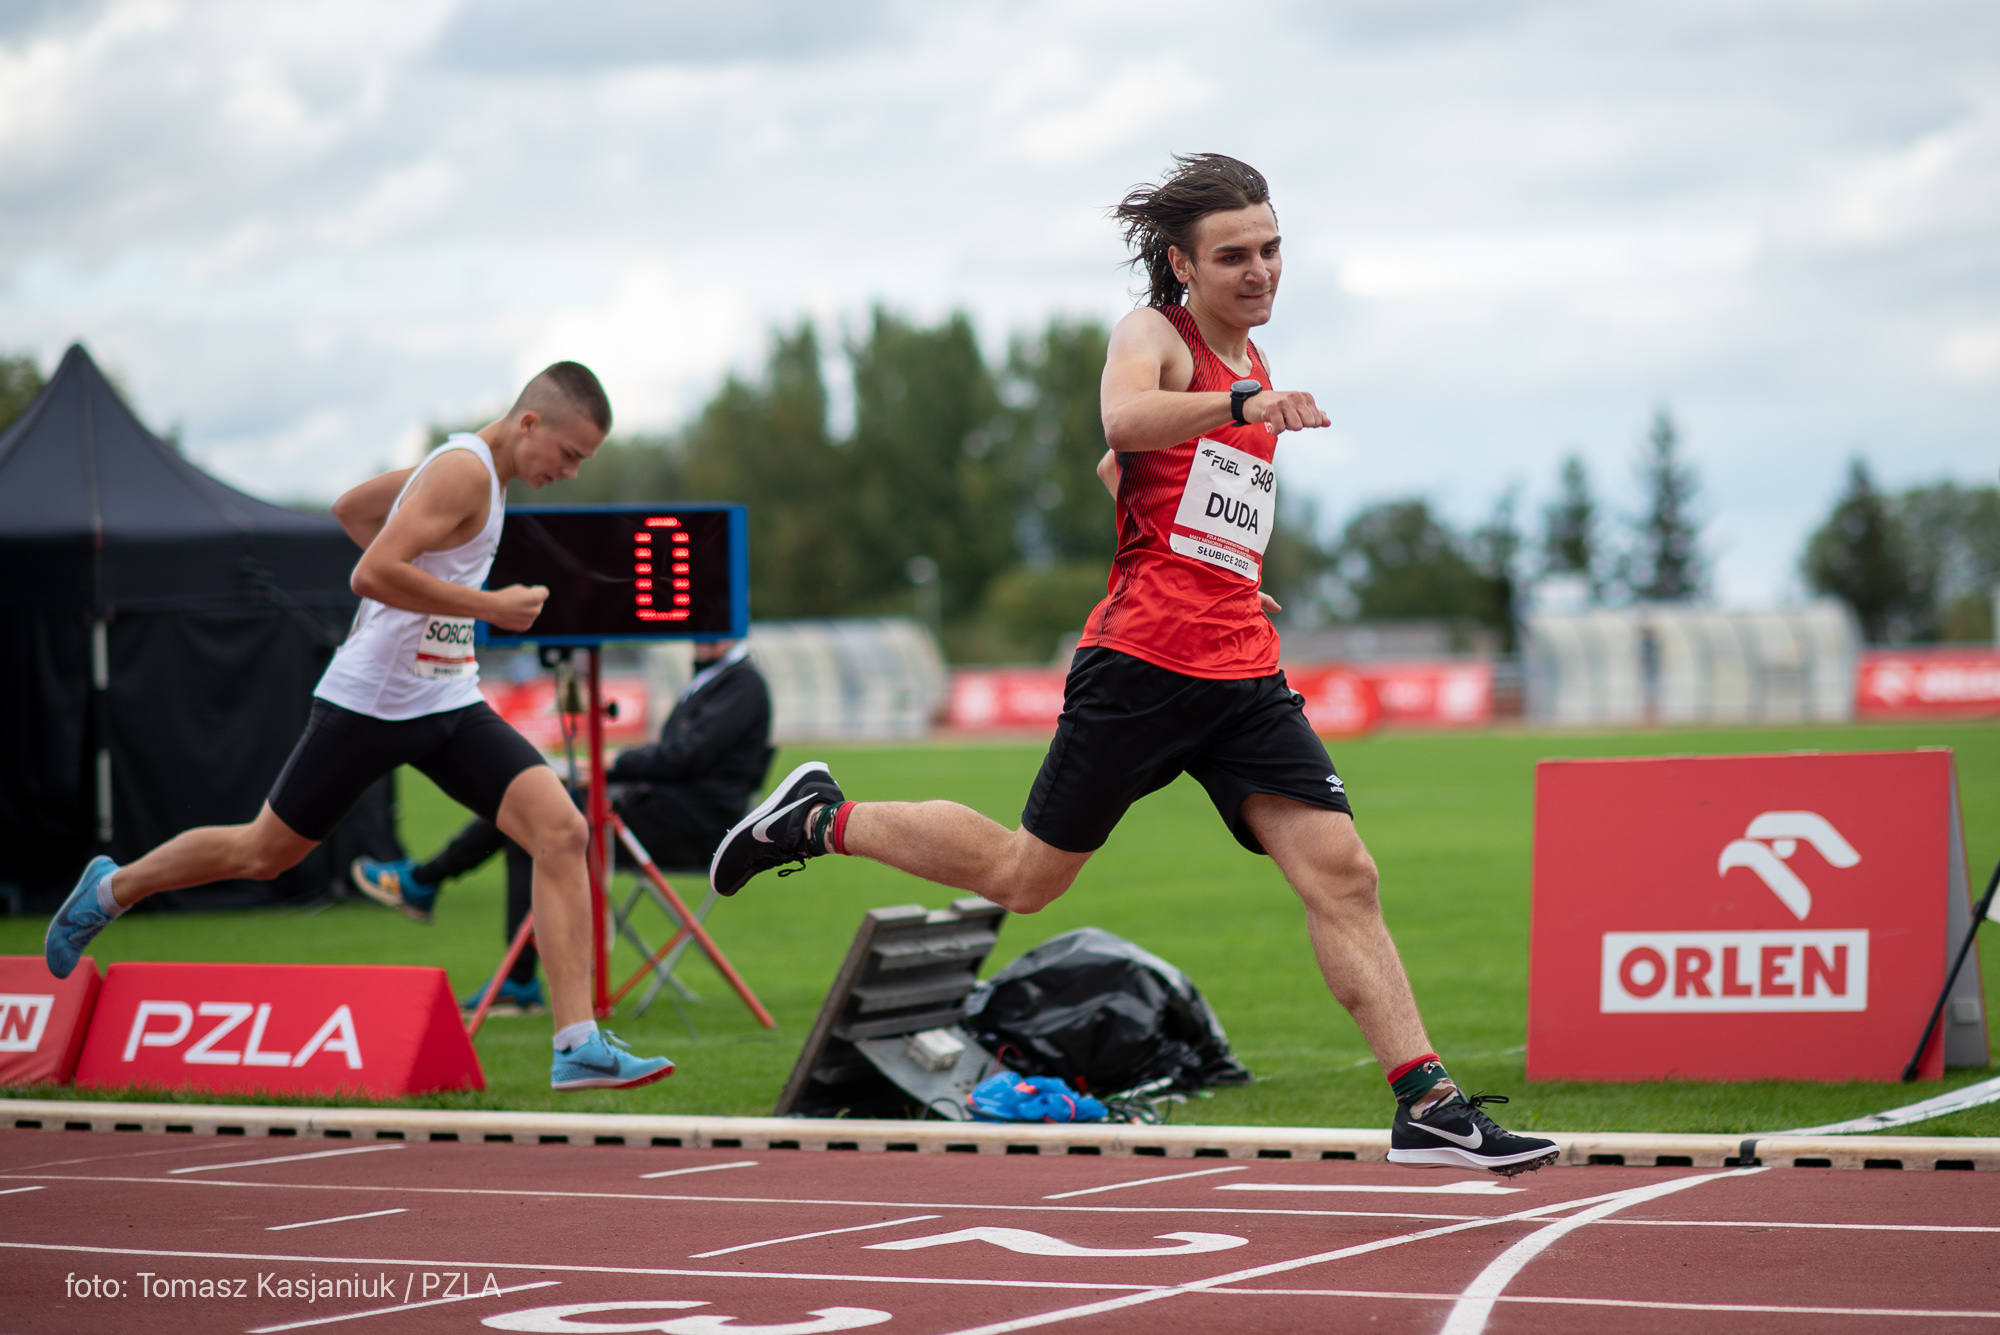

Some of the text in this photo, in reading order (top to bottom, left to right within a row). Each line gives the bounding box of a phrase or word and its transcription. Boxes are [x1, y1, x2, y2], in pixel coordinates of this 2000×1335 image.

[1202, 449, 1240, 477] 4F FUEL
[1251, 464, 1274, 494] 348
[1205, 492, 1258, 535] DUDA
[634, 517, 690, 621] 0
[1197, 546, 1234, 565] SŁUBICE
[1618, 945, 1849, 999] ORLEN
[0, 1005, 39, 1041] N
[122, 1000, 364, 1069] PZLA
[863, 1227, 1249, 1257] 2
[481, 1301, 893, 1335] 3
